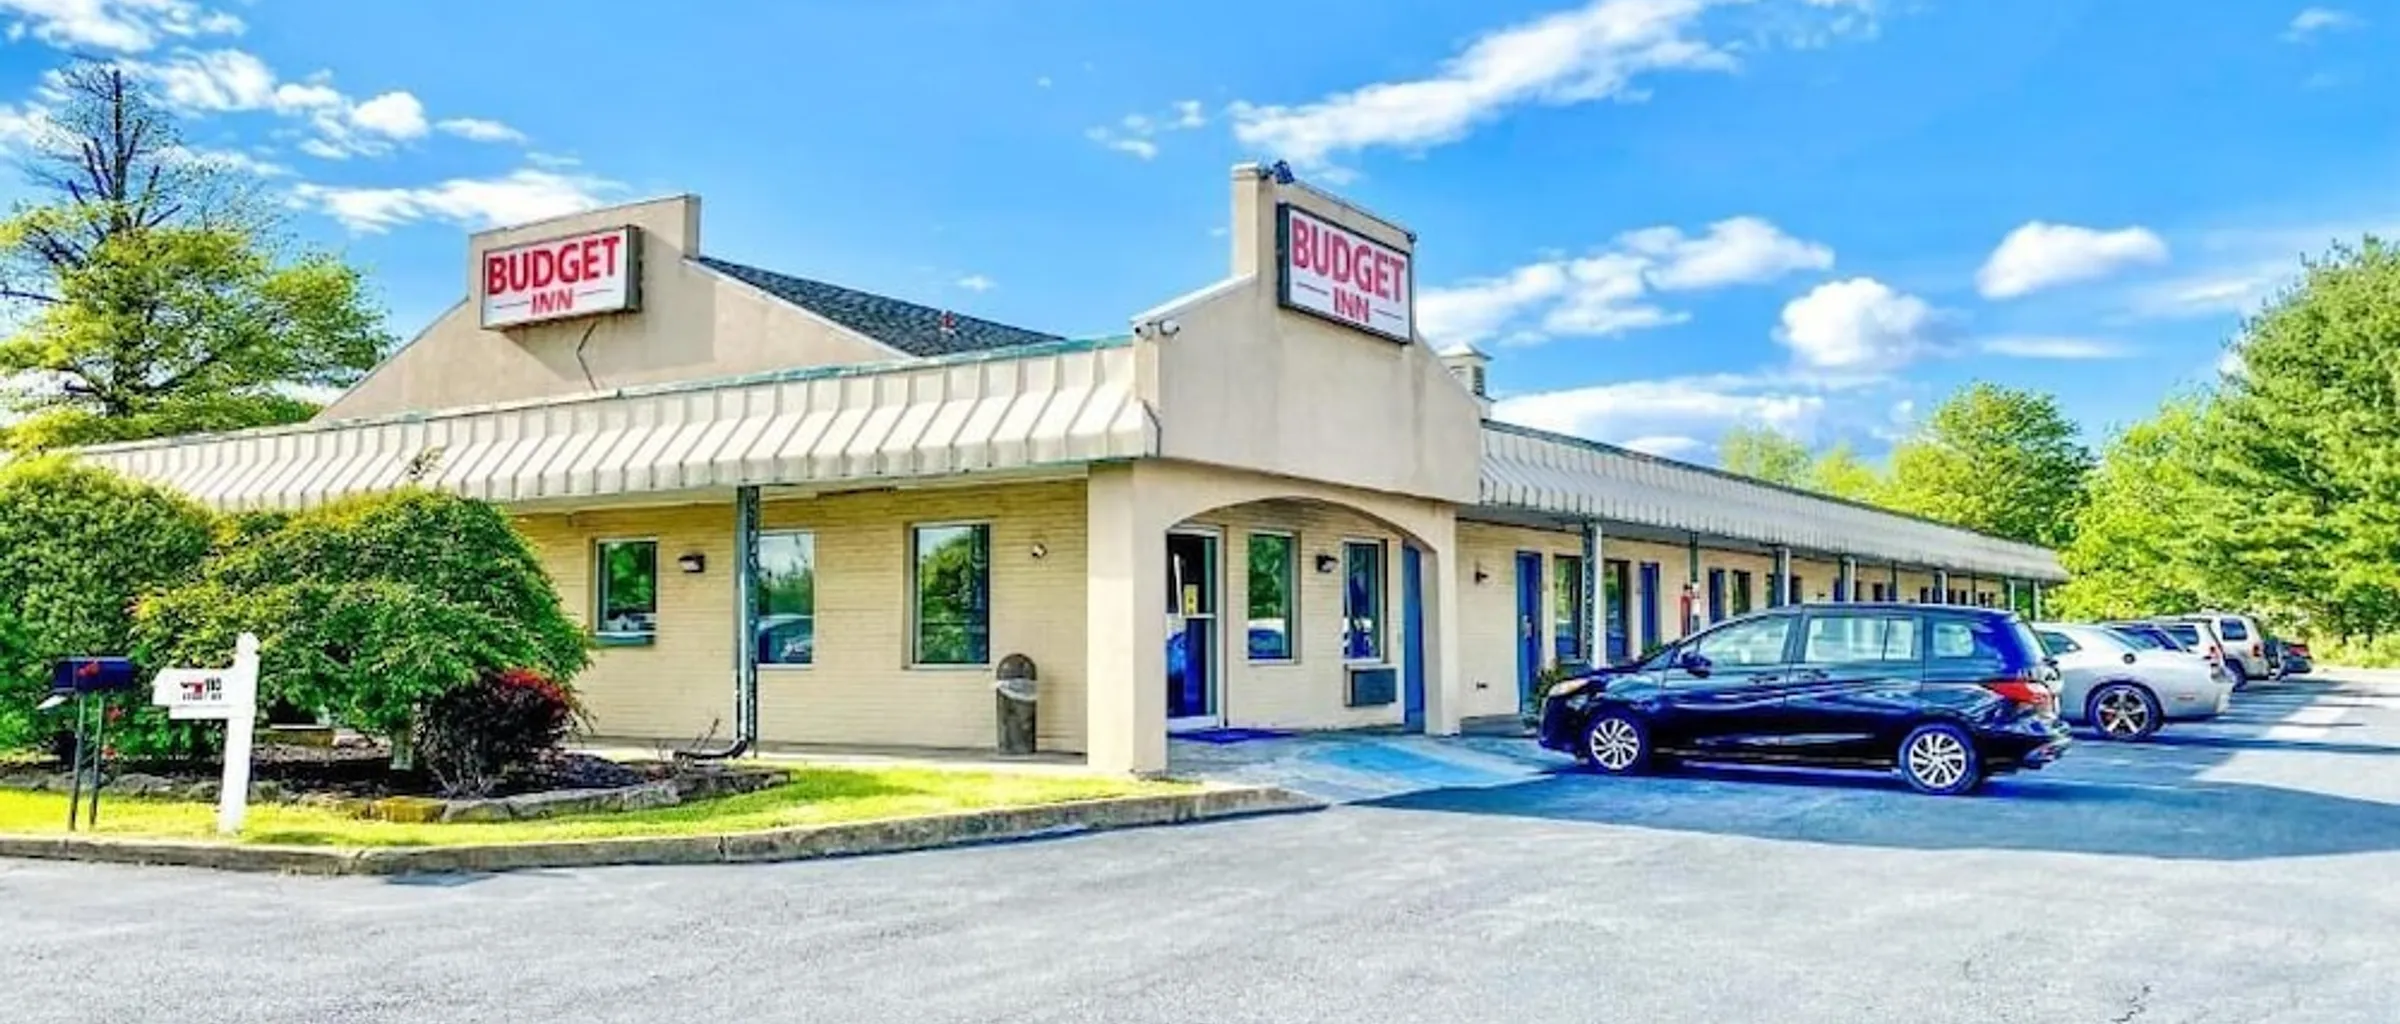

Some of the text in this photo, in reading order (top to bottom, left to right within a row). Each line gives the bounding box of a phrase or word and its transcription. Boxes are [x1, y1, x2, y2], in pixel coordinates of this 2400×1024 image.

[487, 235, 620, 295] BUDGET
[1291, 216, 1404, 302] BUDGET
[530, 288, 573, 315] INN
[1333, 286, 1370, 323] INN
